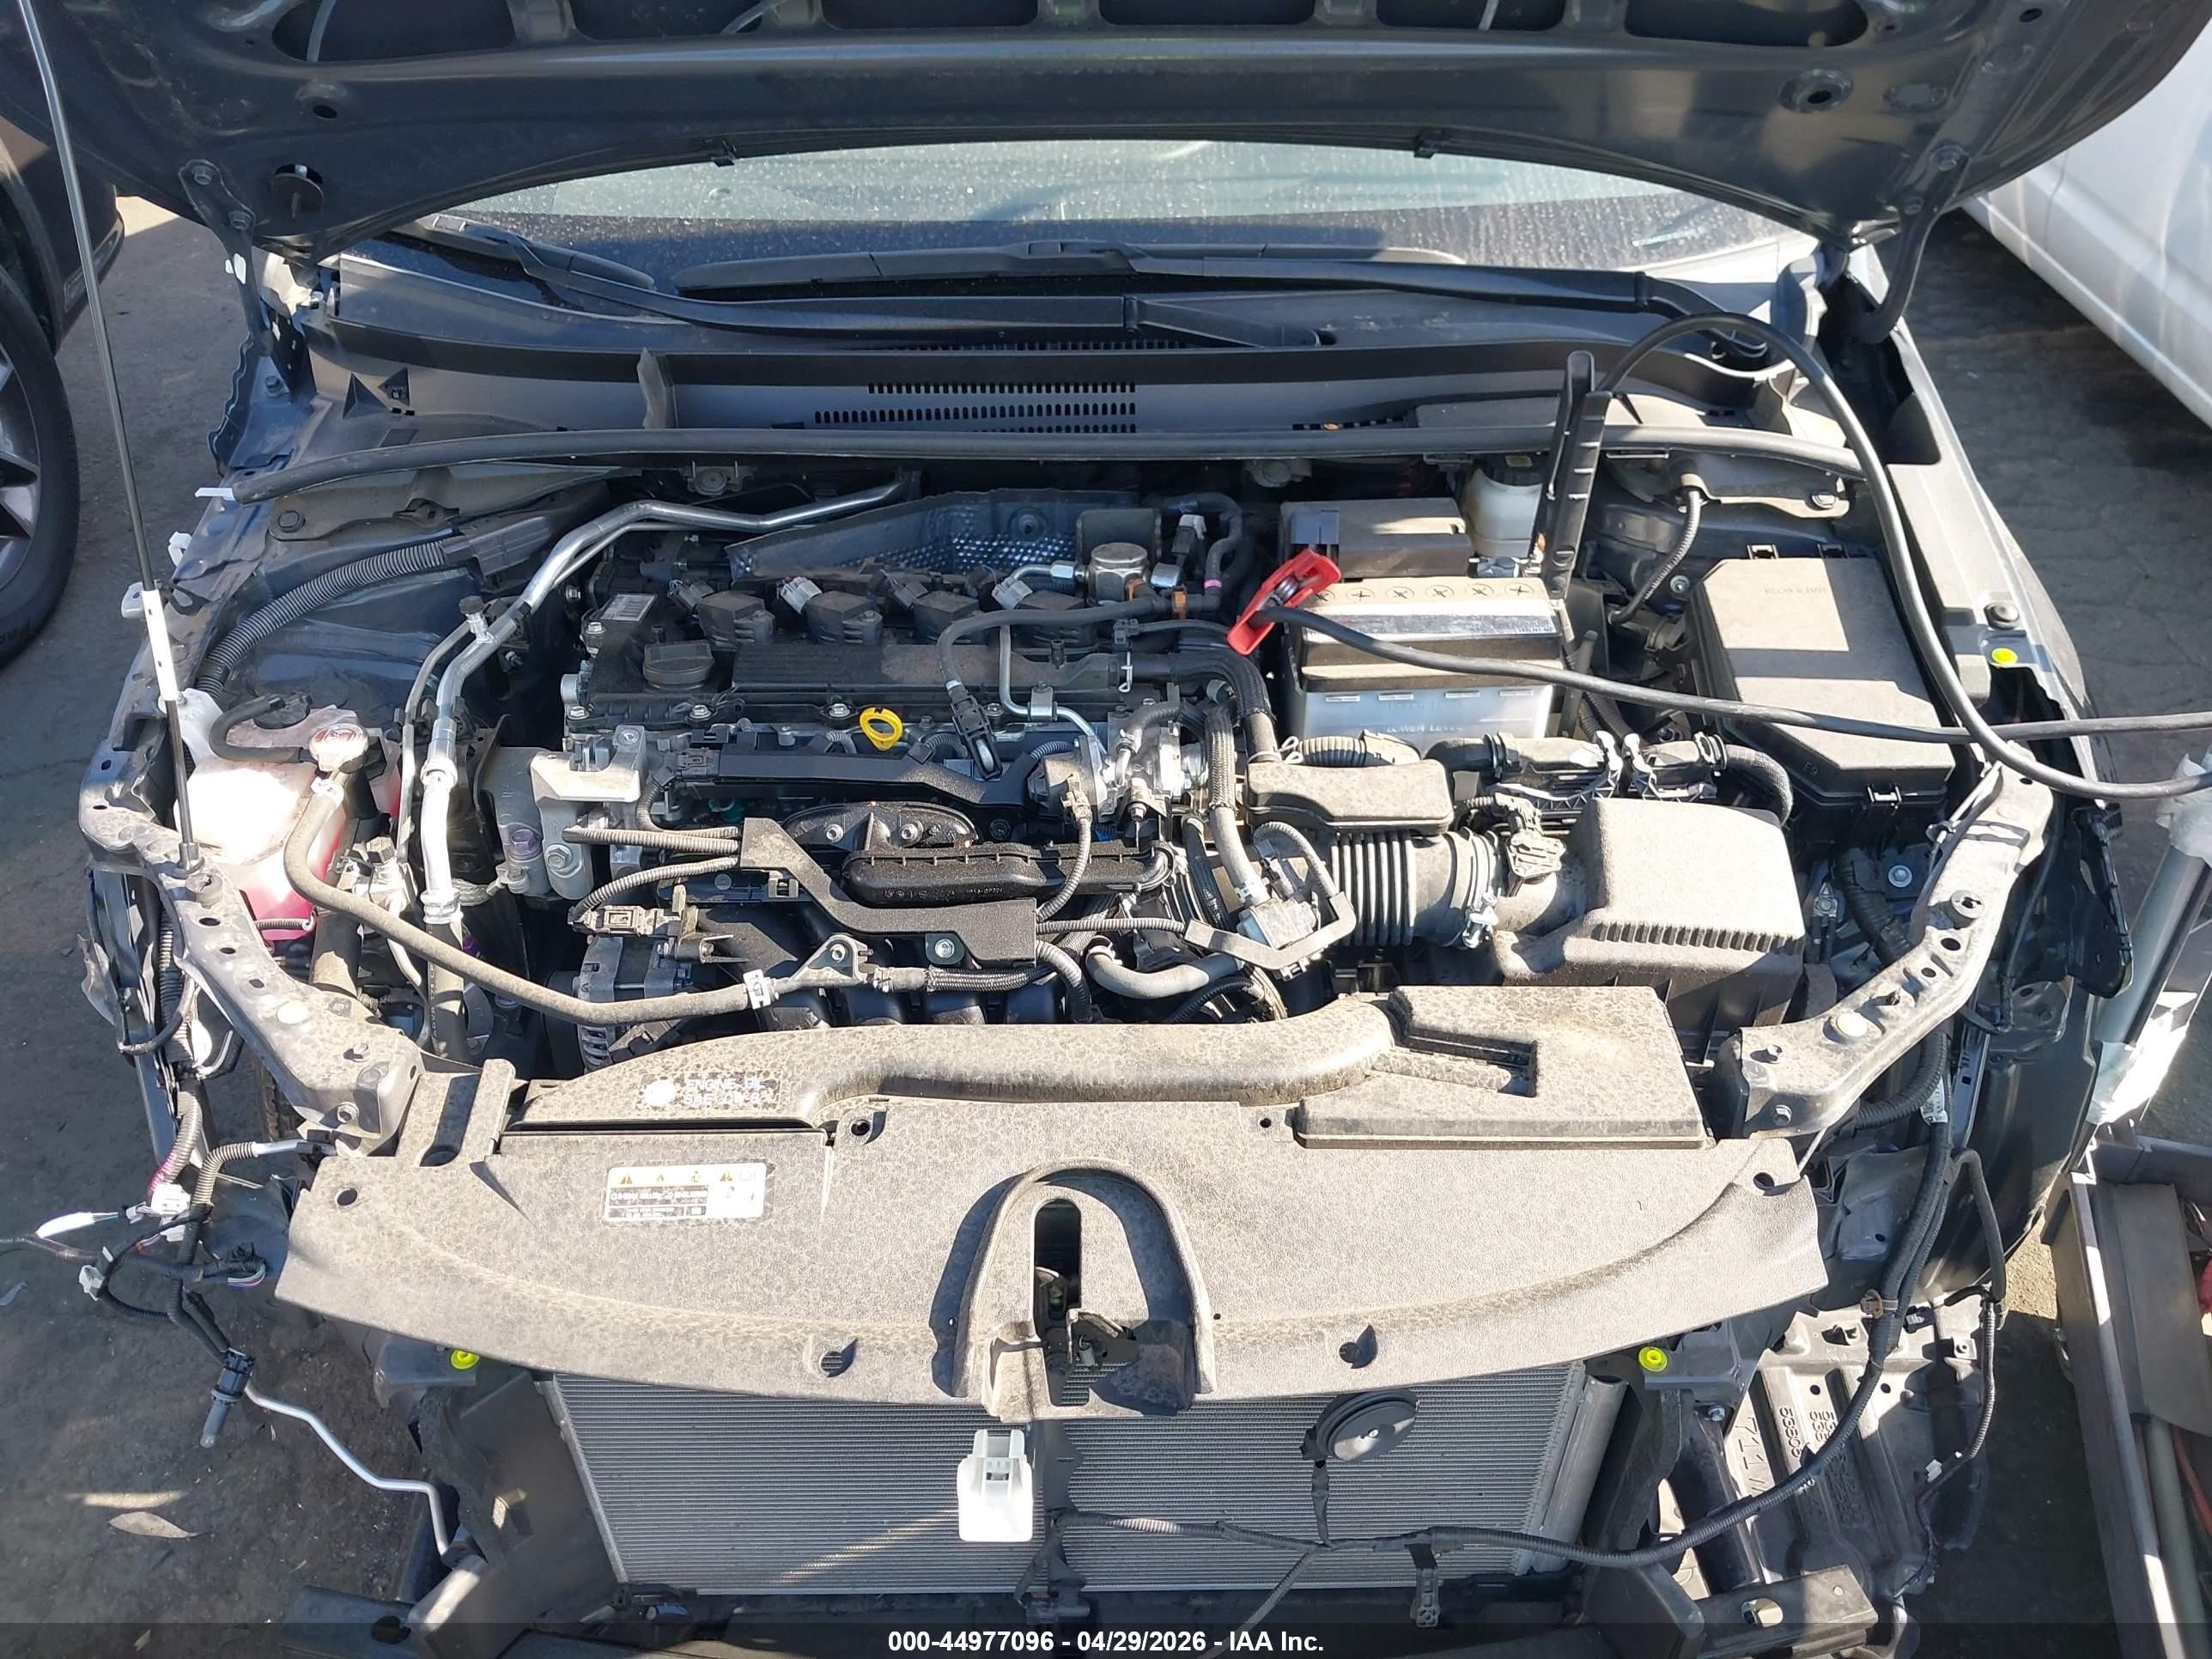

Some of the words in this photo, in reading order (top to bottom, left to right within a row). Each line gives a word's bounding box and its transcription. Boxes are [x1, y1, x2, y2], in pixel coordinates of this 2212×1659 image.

[687, 1079, 738, 1091] ENGINE
[744, 1078, 766, 1091] OIL
[684, 1093, 715, 1108] SAE
